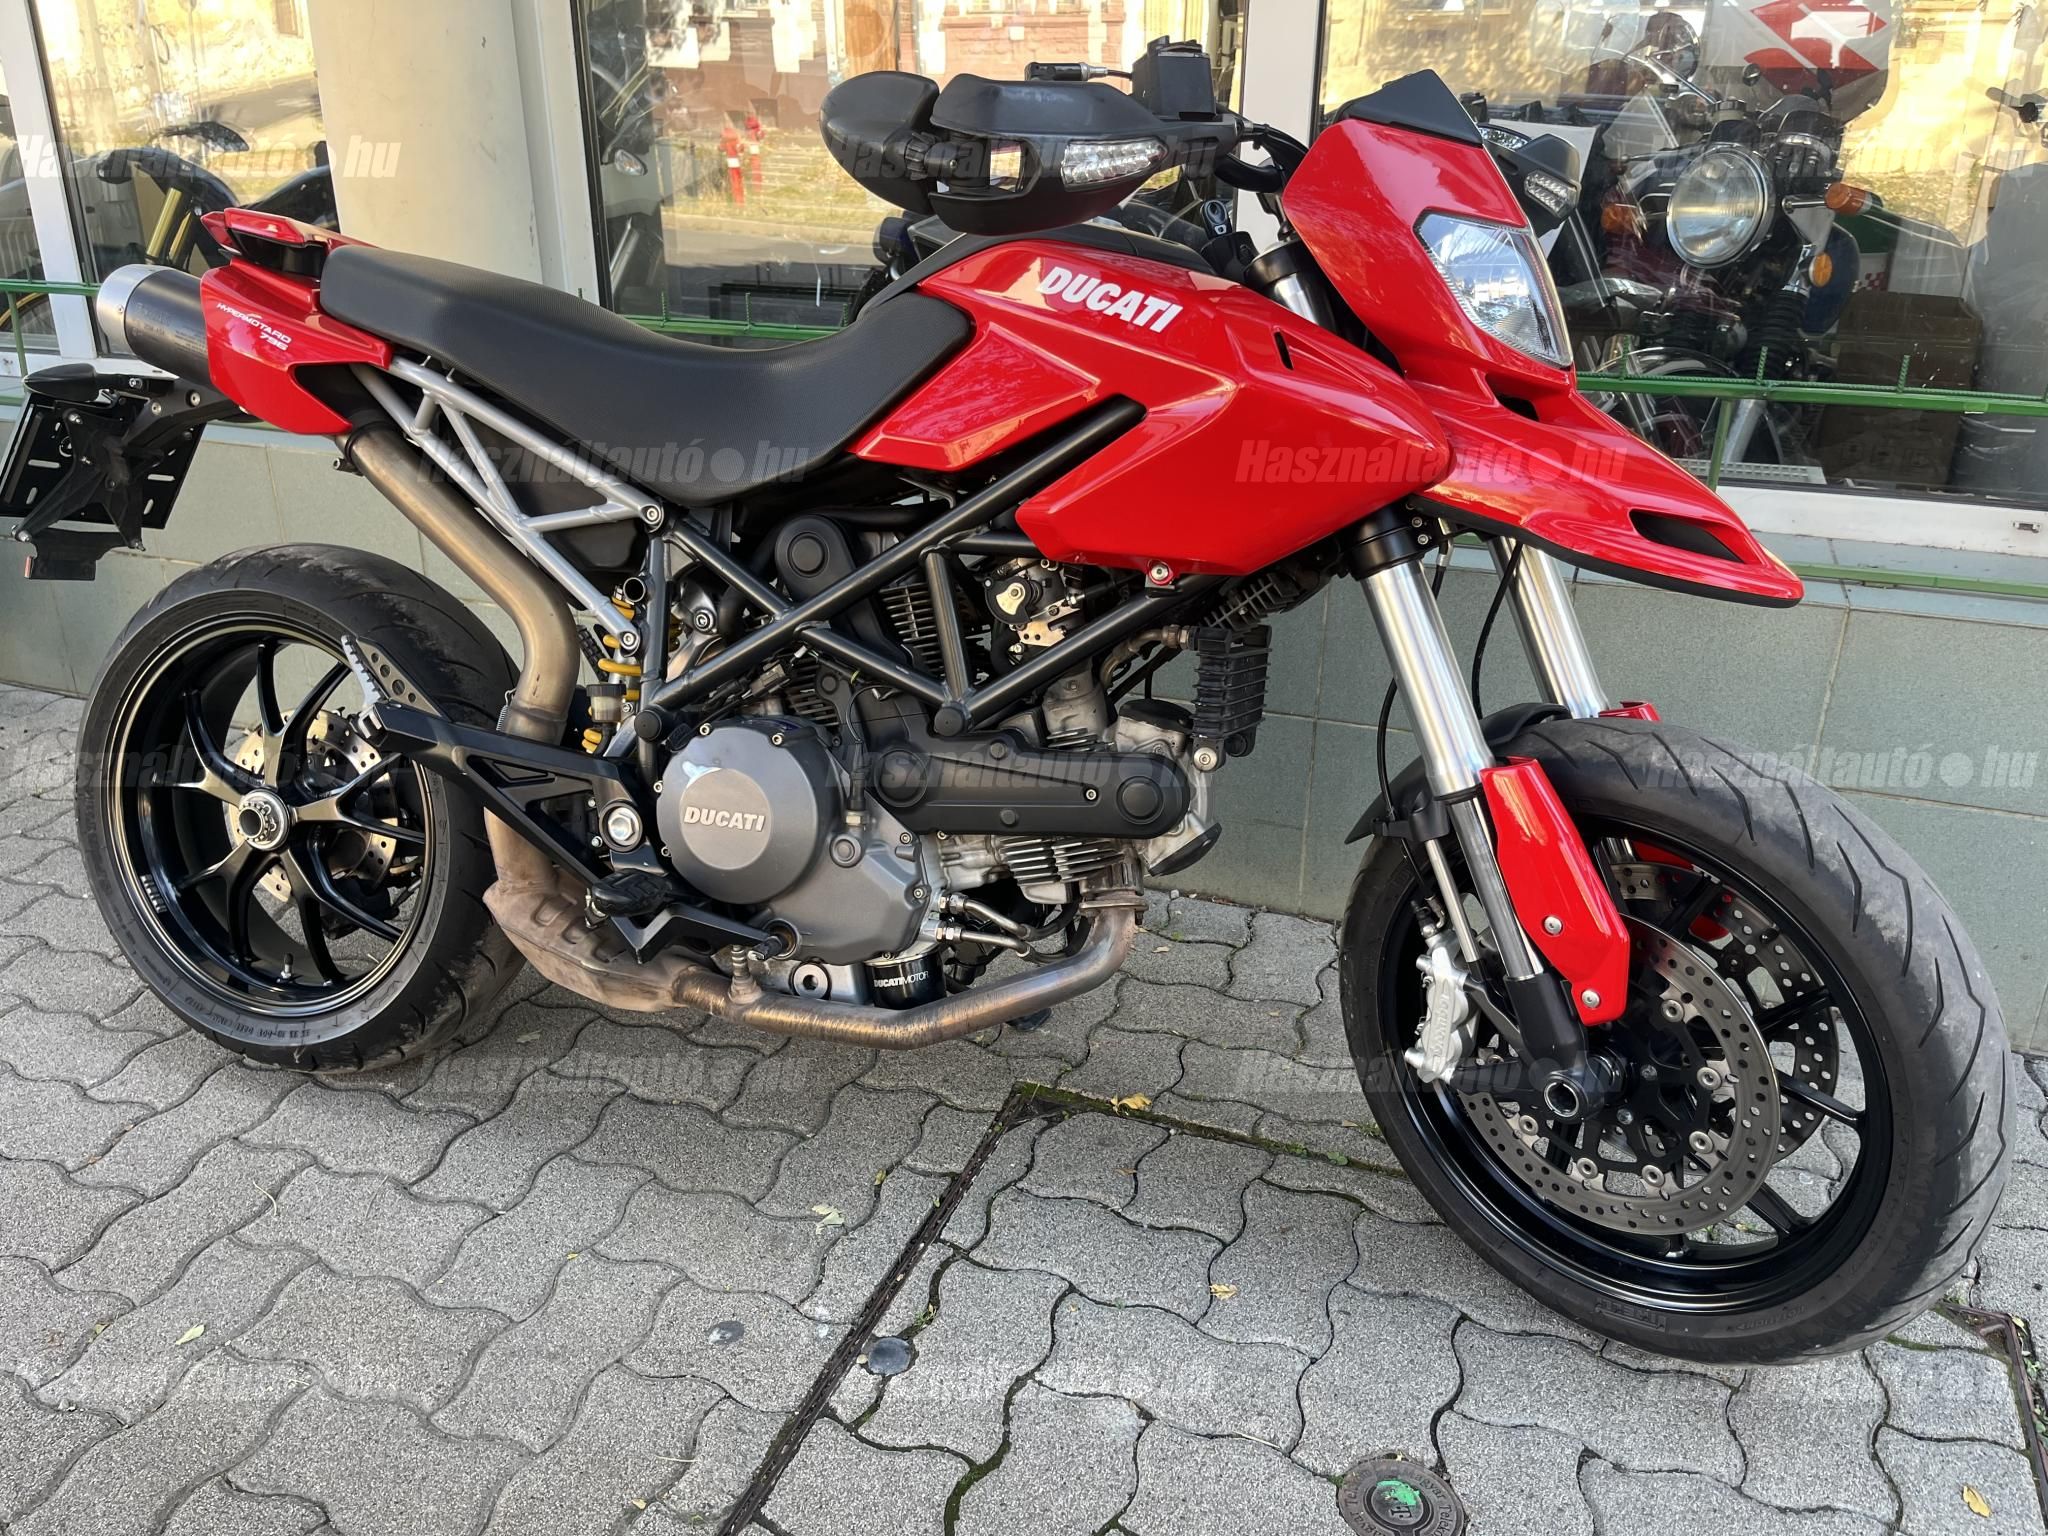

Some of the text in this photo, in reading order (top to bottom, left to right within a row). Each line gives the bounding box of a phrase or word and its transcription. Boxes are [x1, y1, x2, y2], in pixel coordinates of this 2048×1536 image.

[1036, 266, 1184, 333] DUCATI
[216, 302, 292, 344] HYPERMOTARD
[260, 331, 289, 351] 796
[684, 806, 766, 832] DUCATI
[1433, 1504, 1454, 1536] Teleko
